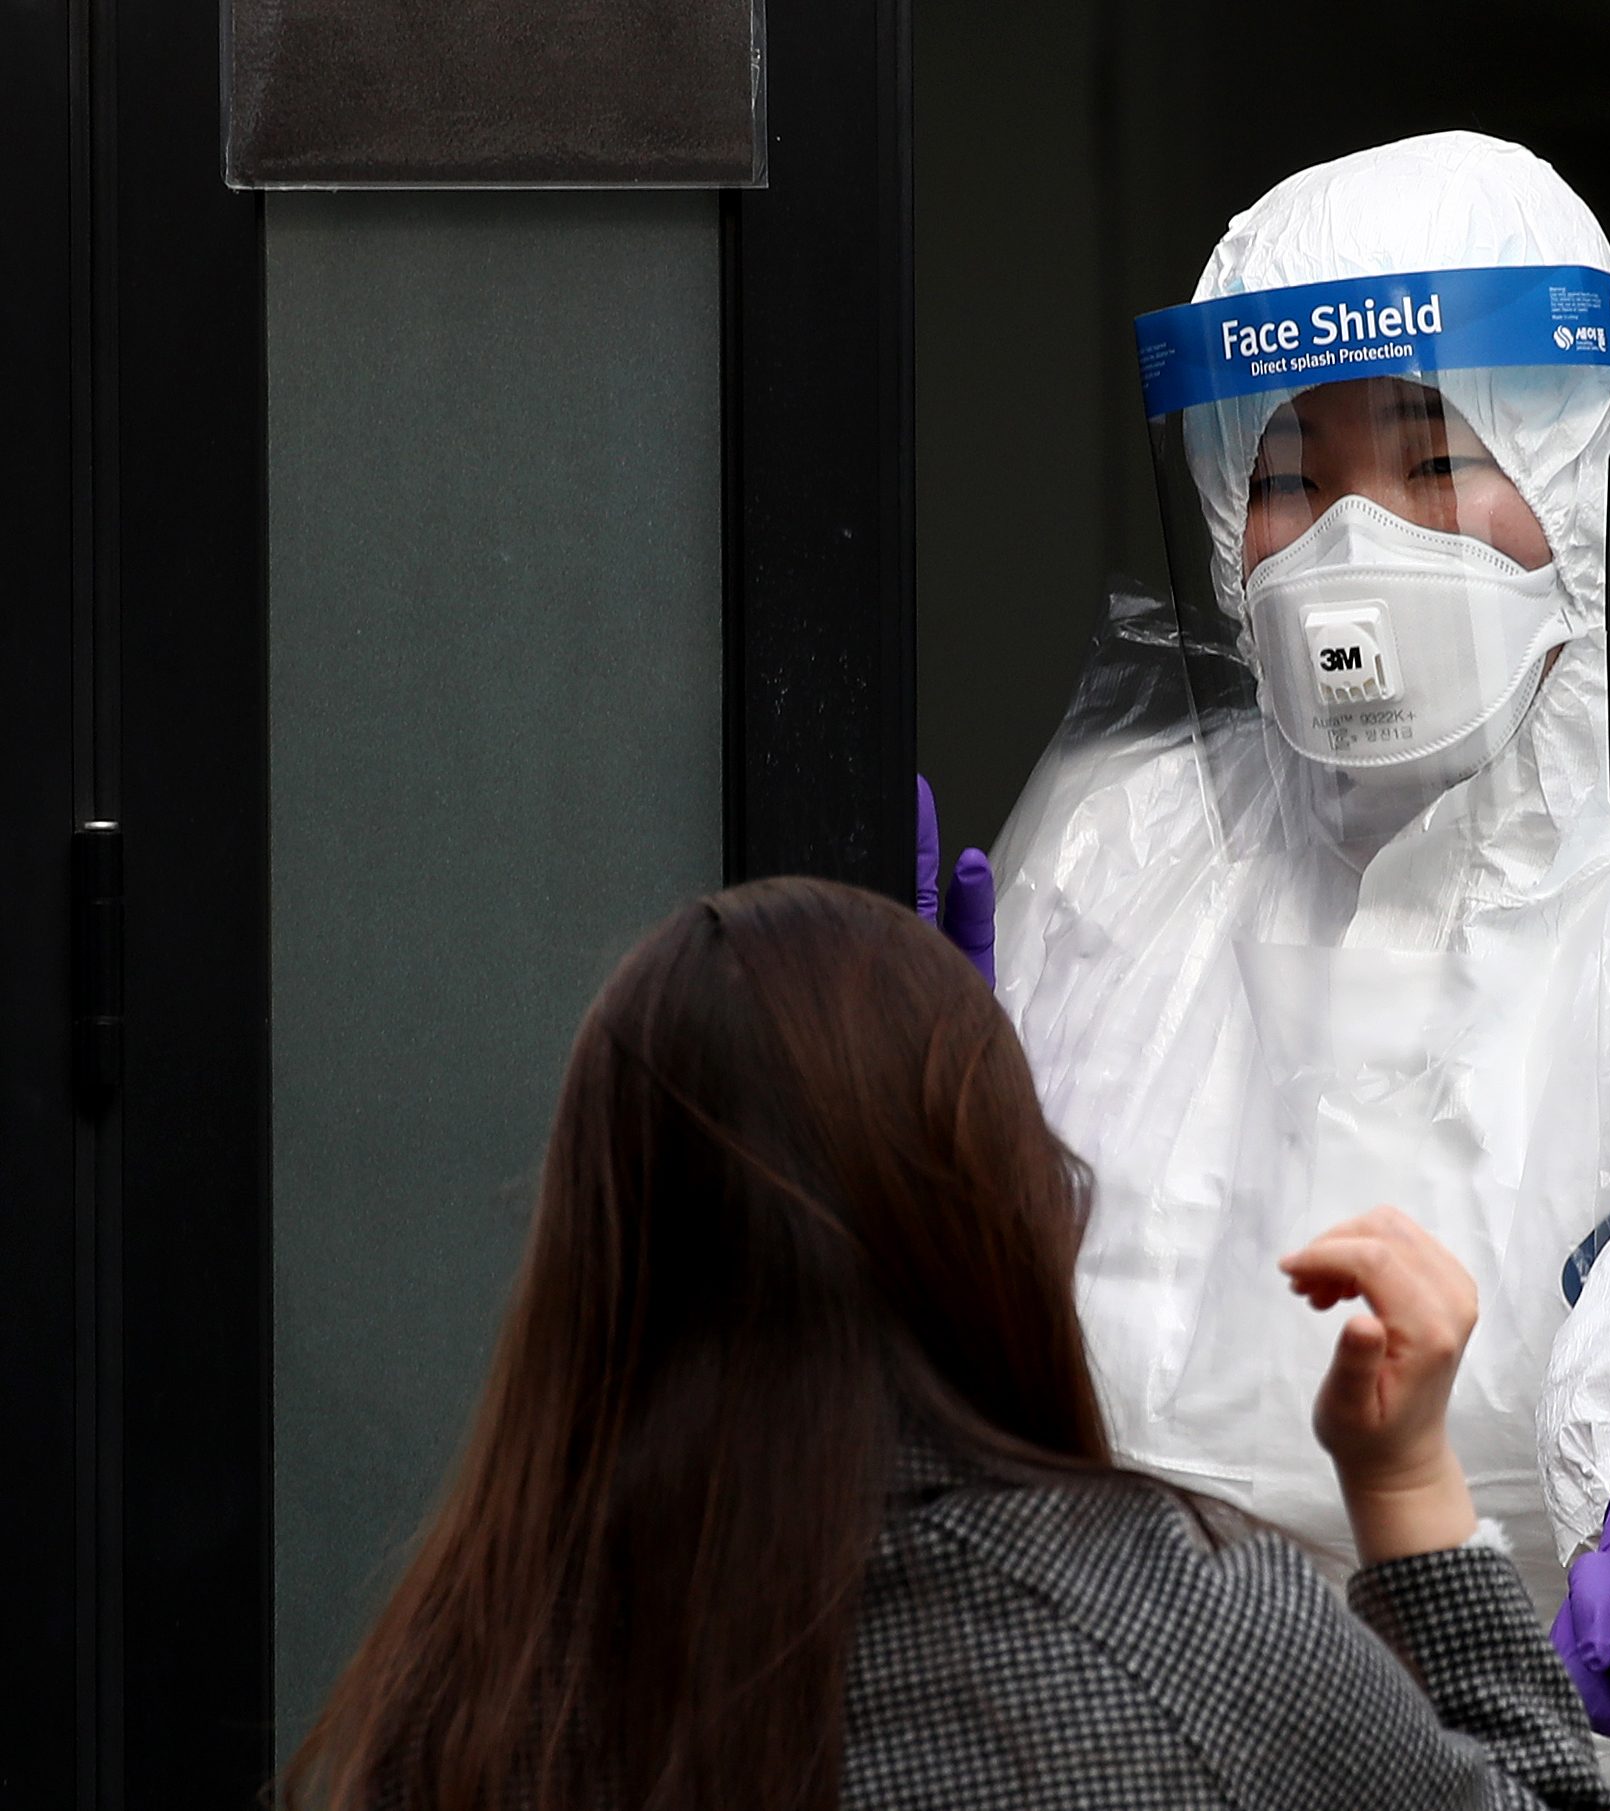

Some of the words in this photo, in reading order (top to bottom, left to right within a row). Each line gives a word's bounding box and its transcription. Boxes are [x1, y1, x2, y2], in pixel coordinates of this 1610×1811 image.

[1222, 320, 1300, 360] Face
[1312, 293, 1443, 346] Shield
[1250, 358, 1290, 378] Direct
[1292, 350, 1337, 374] splash
[1339, 341, 1414, 364] Protection
[1320, 646, 1362, 672] 3M
